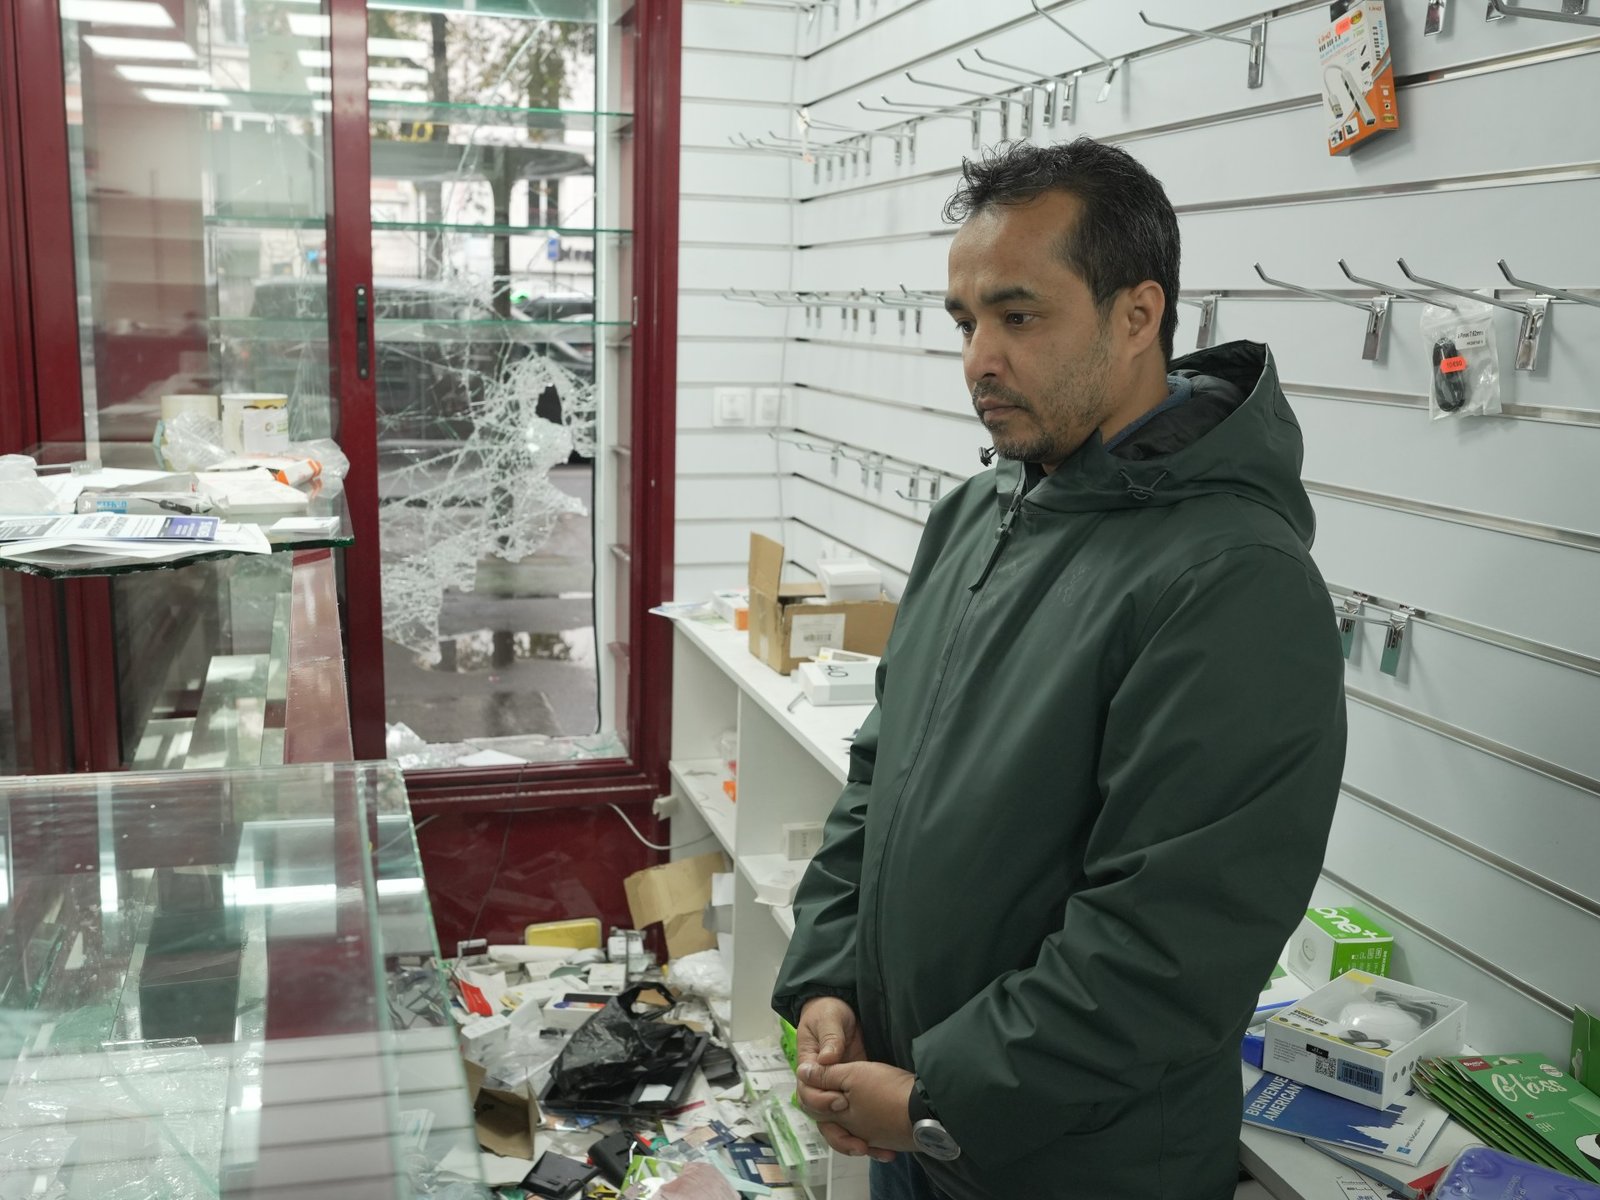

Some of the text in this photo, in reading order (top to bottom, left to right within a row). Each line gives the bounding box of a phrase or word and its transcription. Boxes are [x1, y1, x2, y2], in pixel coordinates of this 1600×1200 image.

[1245, 1075, 1289, 1117] BIENVENUE
[1262, 1083, 1304, 1122] AMERICAN
[1491, 1073, 1568, 1102] Glass
